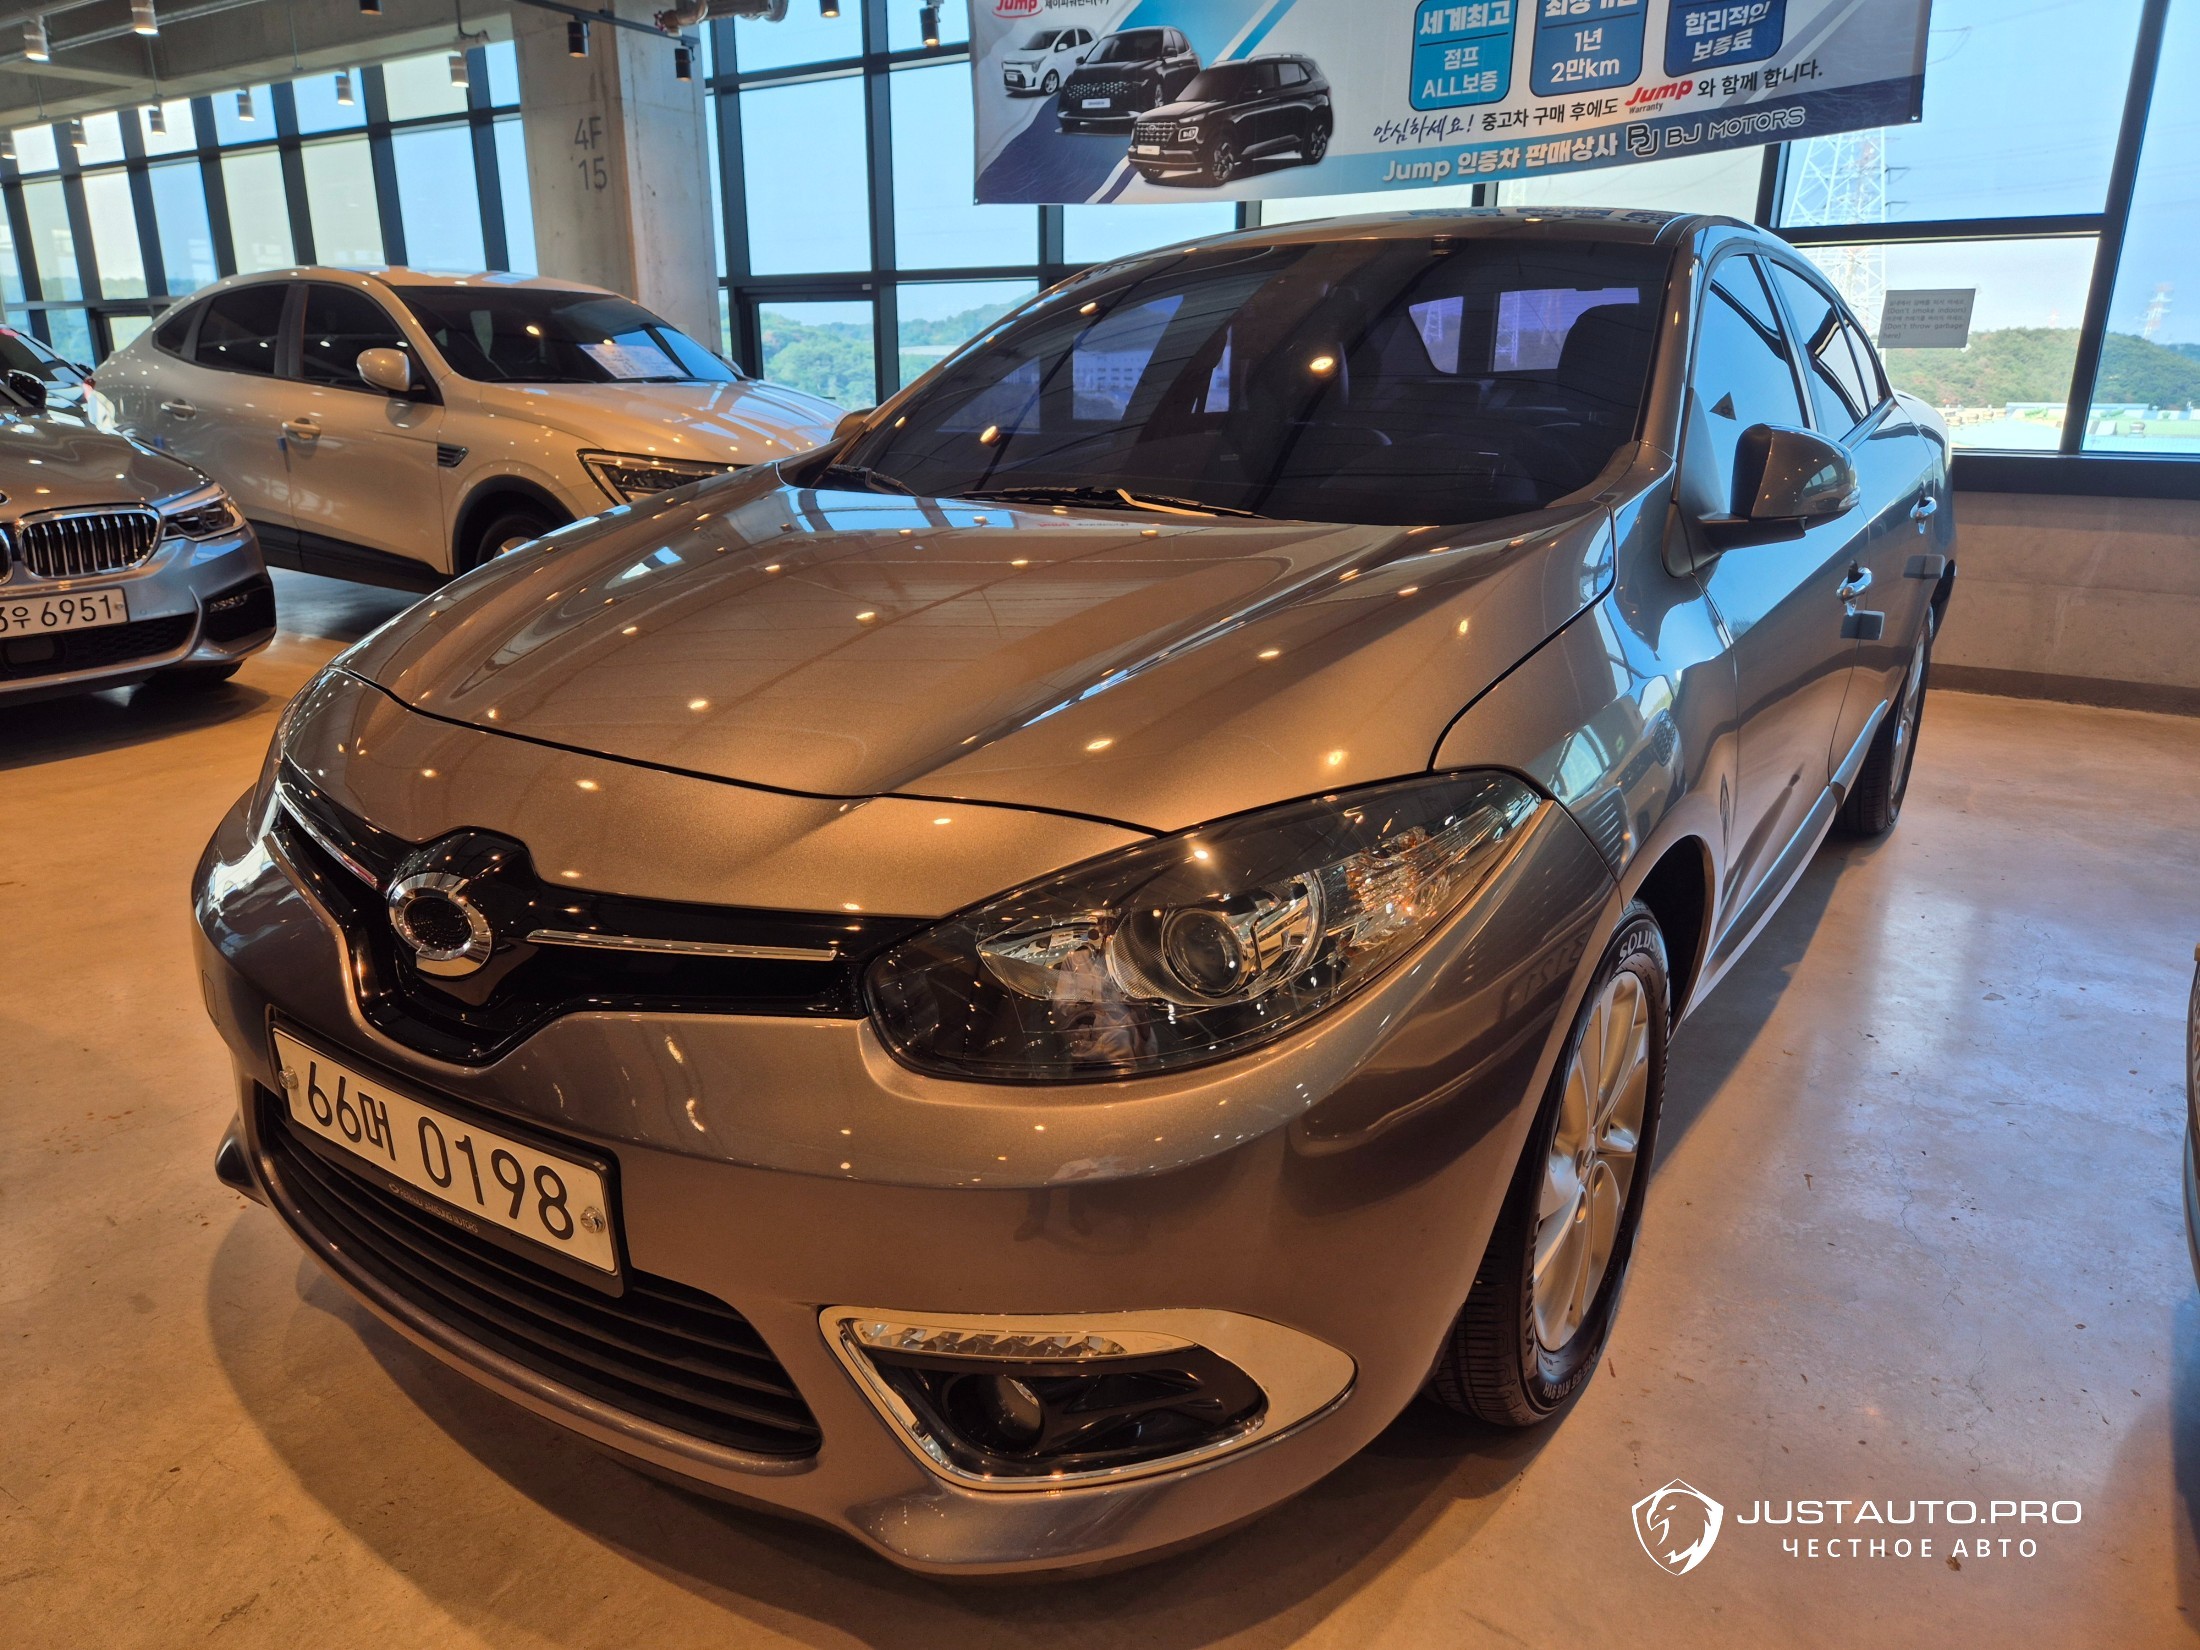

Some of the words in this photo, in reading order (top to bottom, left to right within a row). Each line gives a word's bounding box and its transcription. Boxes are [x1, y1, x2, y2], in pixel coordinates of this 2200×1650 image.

[1419, 0, 1510, 35] 세계최고
[1685, 1, 1770, 36] 합리적인
[1574, 28, 1602, 52] 1년
[1692, 28, 1752, 63] 보증료
[1444, 47, 1479, 71] 점프
[1550, 58, 1620, 84] 2만km
[1373, 114, 1475, 144] 안심하세요!
[1482, 110, 1529, 131] 중고차
[1533, 104, 1565, 126] 구매
[1569, 98, 1619, 120] 후에도
[1625, 80, 1693, 106] Jump
[1697, 78, 1716, 98] 와
[1721, 73, 1758, 96] 함께
[1764, 59, 1823, 88] 합니다.
[1421, 71, 1498, 99] ALL보증
[1629, 102, 1664, 114] Warranty
[574, 116, 602, 150] 4F
[1665, 124, 1702, 147] BJ
[1707, 106, 1806, 141] MOTORS
[578, 156, 608, 191] 15
[1382, 159, 1451, 183] Jump
[1457, 147, 1520, 176] 인증차
[1525, 132, 1619, 166] 판매상사
[1934, 322, 1964, 331] garbage
[40, 594, 112, 627] 6951
[1618, 929, 1658, 965] SOLUS
[307, 1060, 397, 1161] 66머
[417, 1115, 575, 1241] 0198
